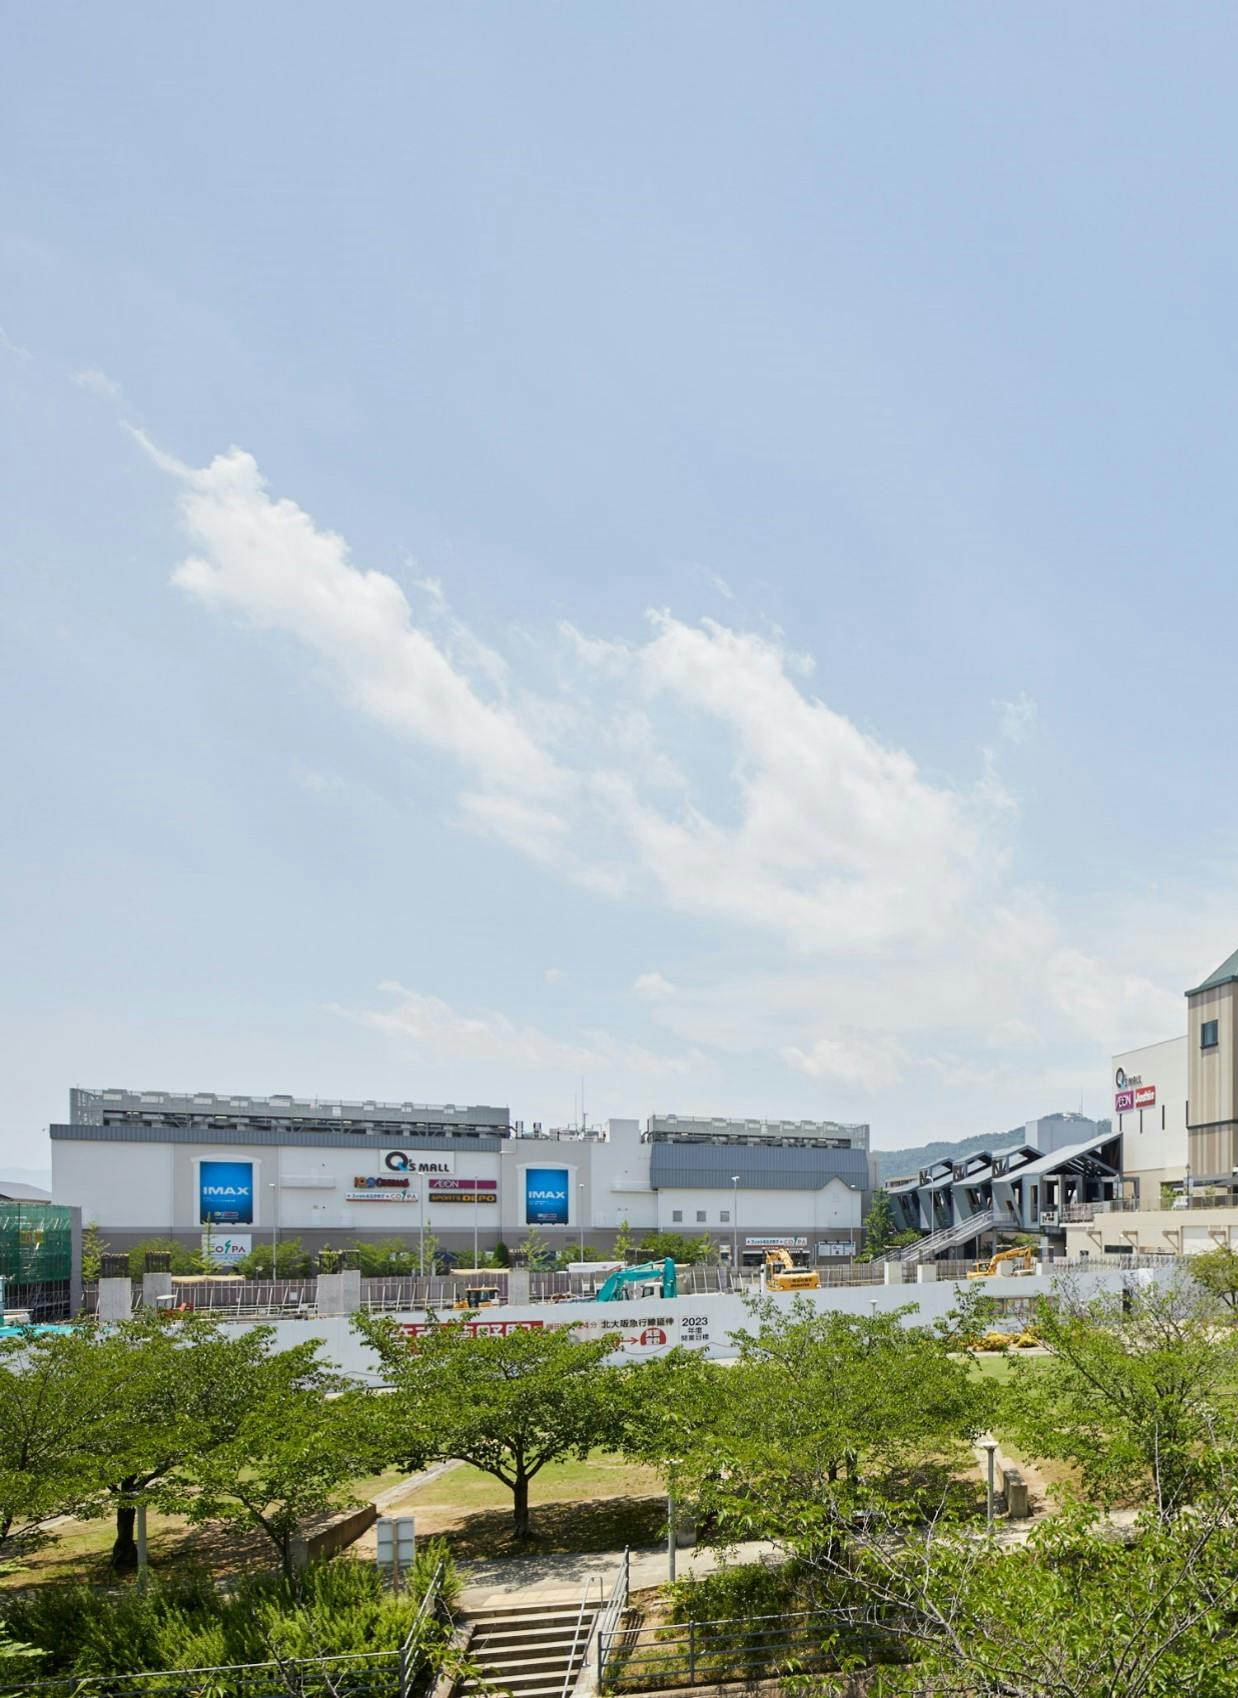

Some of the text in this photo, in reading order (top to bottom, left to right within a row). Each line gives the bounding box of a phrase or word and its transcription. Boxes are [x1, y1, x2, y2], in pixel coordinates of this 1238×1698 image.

[418, 1163, 450, 1172] MALL
[203, 1186, 249, 1195] IMAX
[528, 1190, 566, 1199] IMAX
[682, 1317, 709, 1327] 2023
